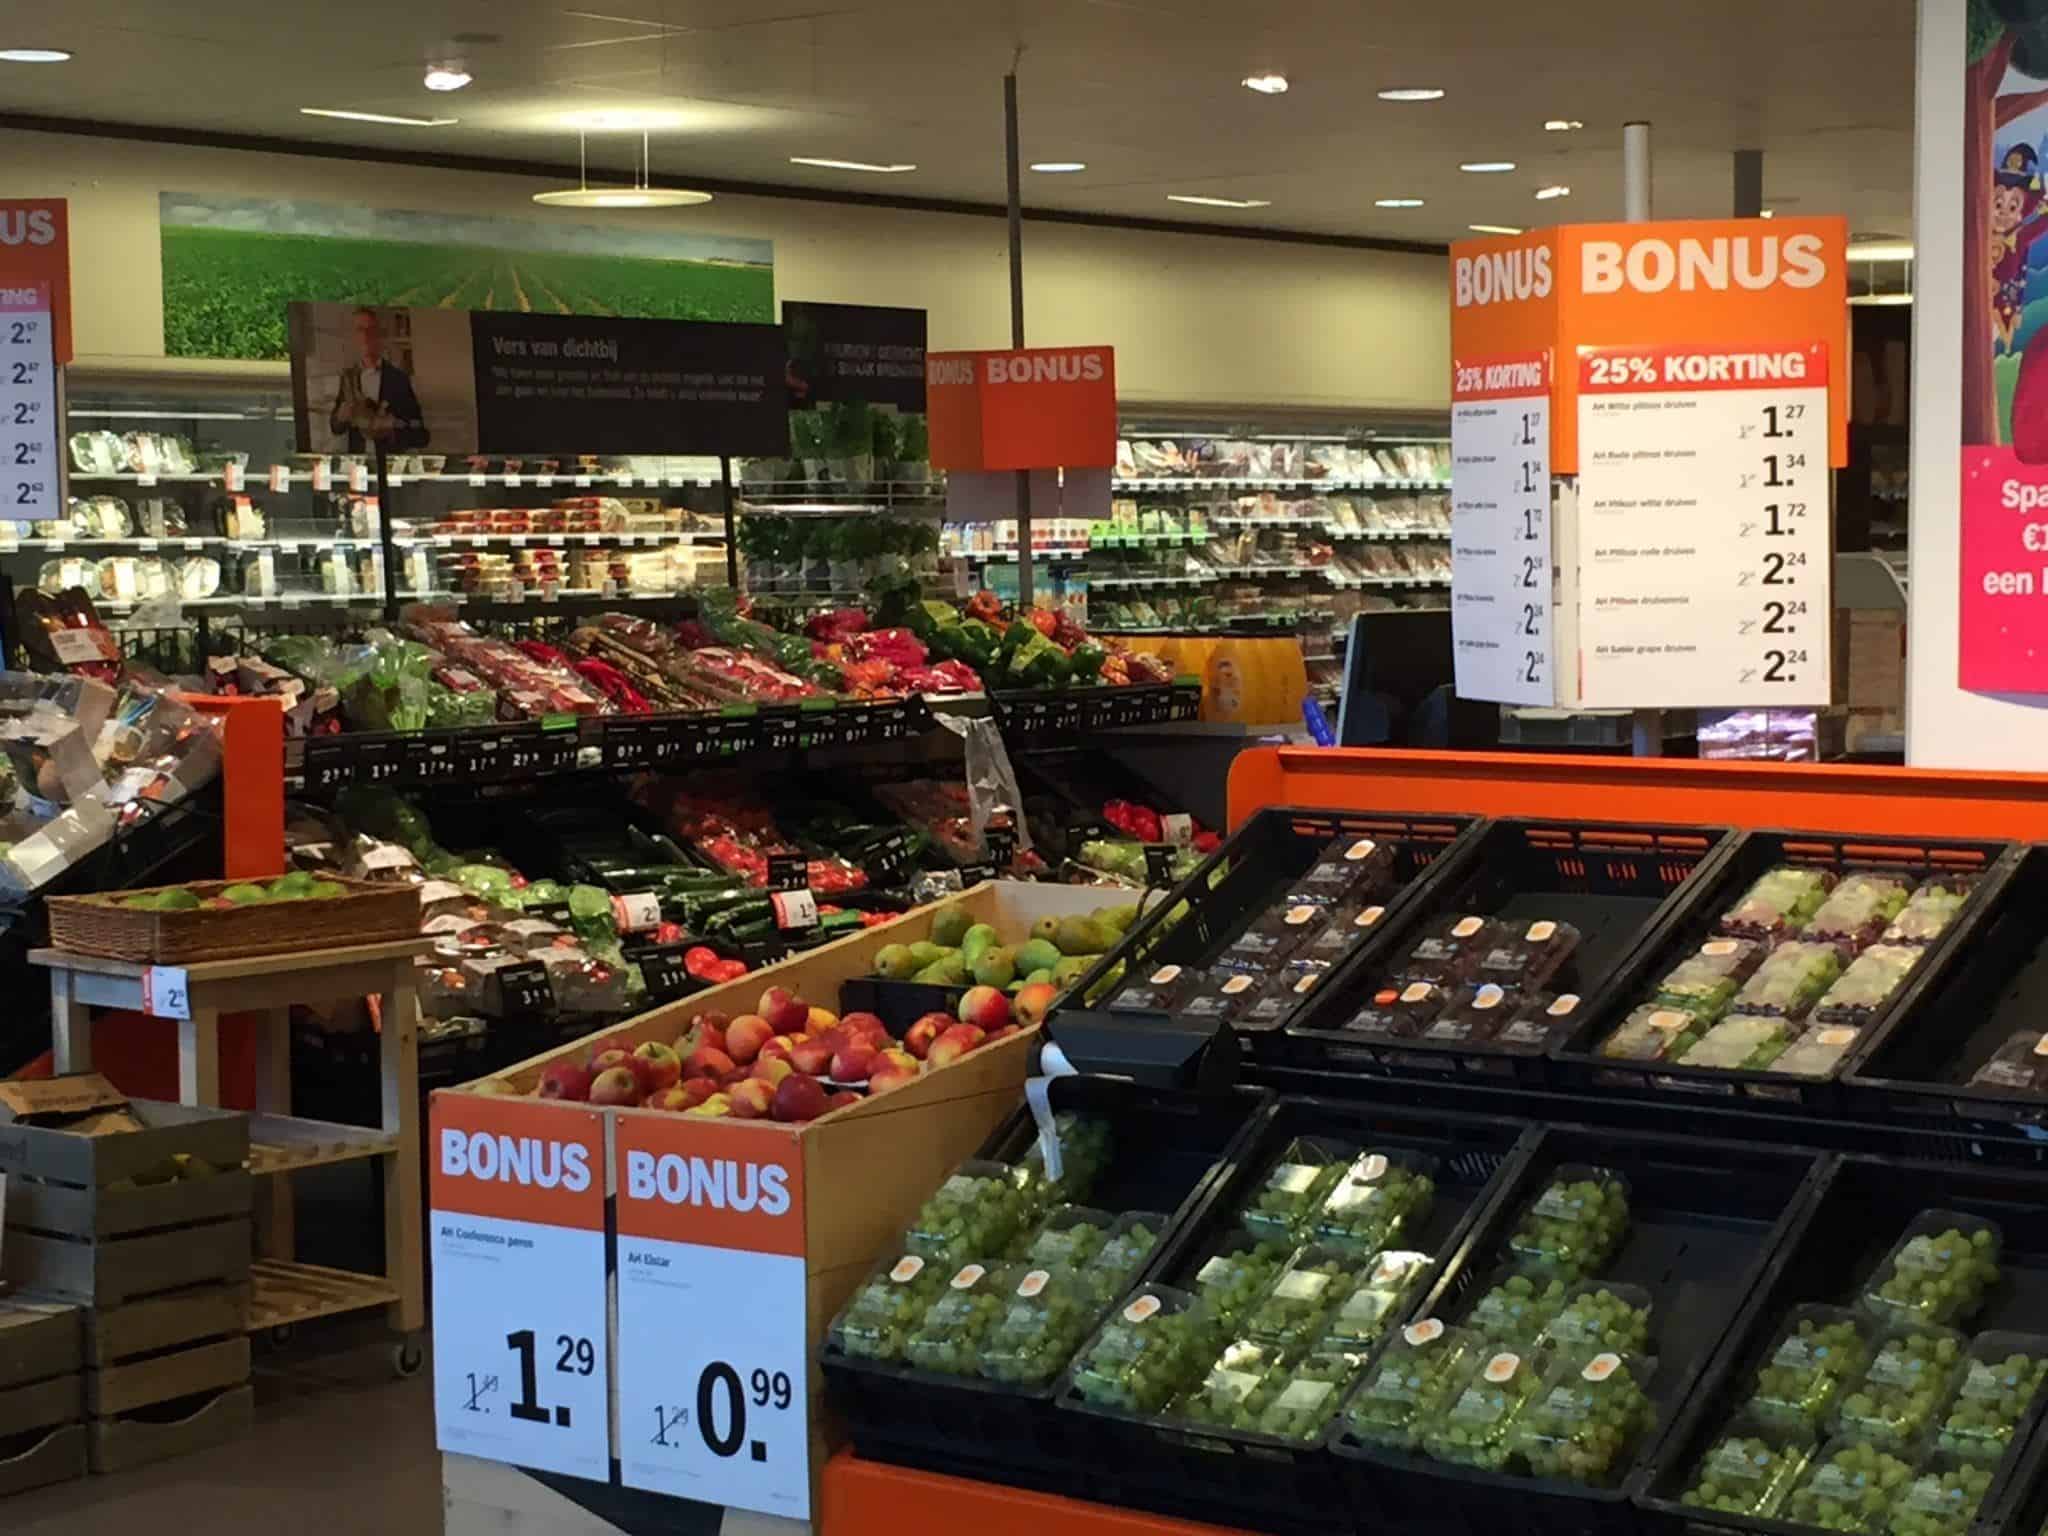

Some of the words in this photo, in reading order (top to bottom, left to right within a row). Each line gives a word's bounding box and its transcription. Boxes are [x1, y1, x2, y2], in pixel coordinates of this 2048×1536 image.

[1456, 244, 1552, 307] BONUS
[1581, 234, 1826, 295] BONUS
[532, 340, 558, 357] van
[986, 354, 1104, 384] BONUS
[1456, 367, 1483, 392] 25%
[1485, 362, 1541, 390] KORTING
[1590, 356, 1657, 384] 25%
[1665, 352, 1806, 382] KORTING
[1983, 571, 2033, 595] een
[440, 1128, 592, 1193] BONUS
[626, 1150, 792, 1217] BONUS
[506, 1329, 595, 1428] 1.29
[696, 1360, 793, 1463] 0.99
